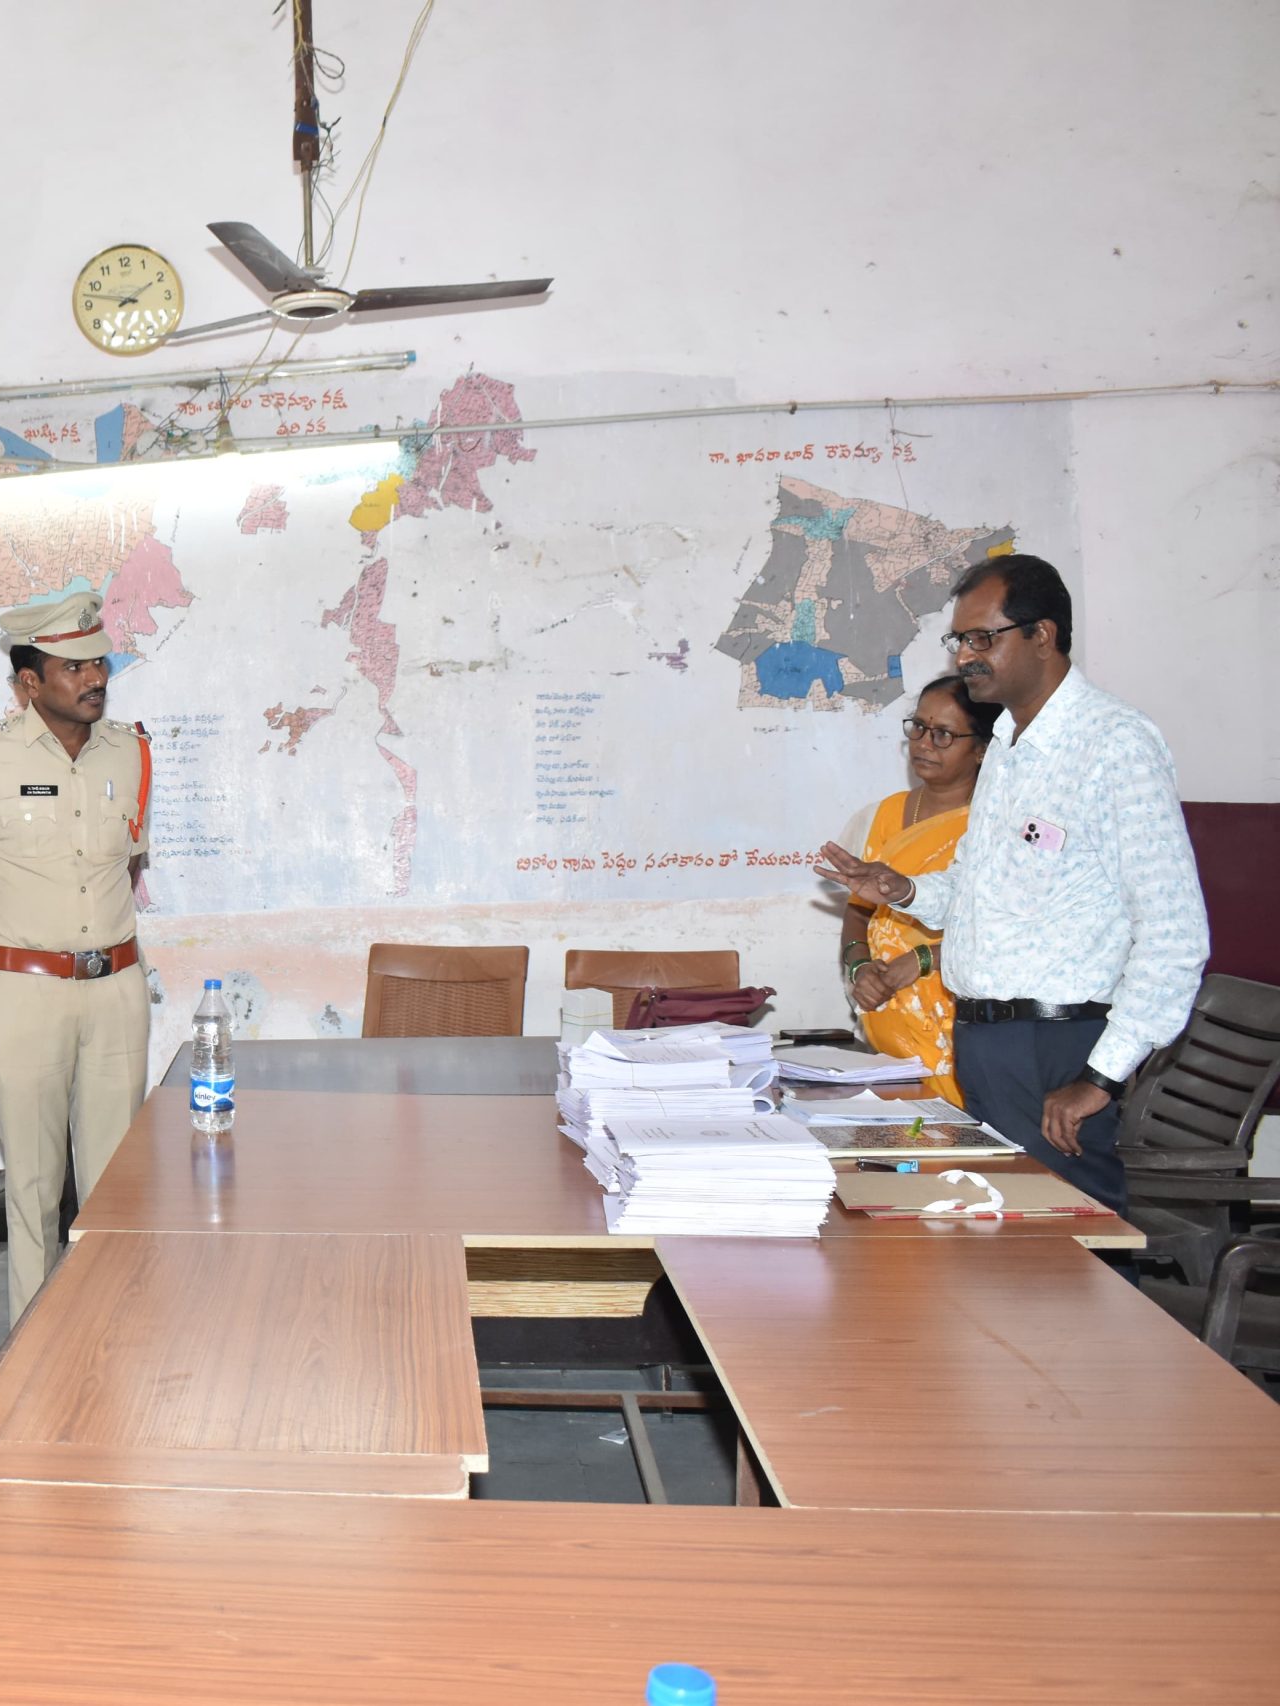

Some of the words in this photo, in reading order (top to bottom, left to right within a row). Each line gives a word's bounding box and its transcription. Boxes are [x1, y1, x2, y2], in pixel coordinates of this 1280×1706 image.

[118, 256, 130, 268] 12
[140, 259, 146, 270] 1
[100, 265, 111, 276] 11
[156, 271, 165, 282] 2
[89, 280, 102, 292] 10
[164, 289, 172, 300] 3
[84, 300, 93, 311] 9
[92, 318, 102, 329] 8
[194, 1092, 216, 1101] kinley
